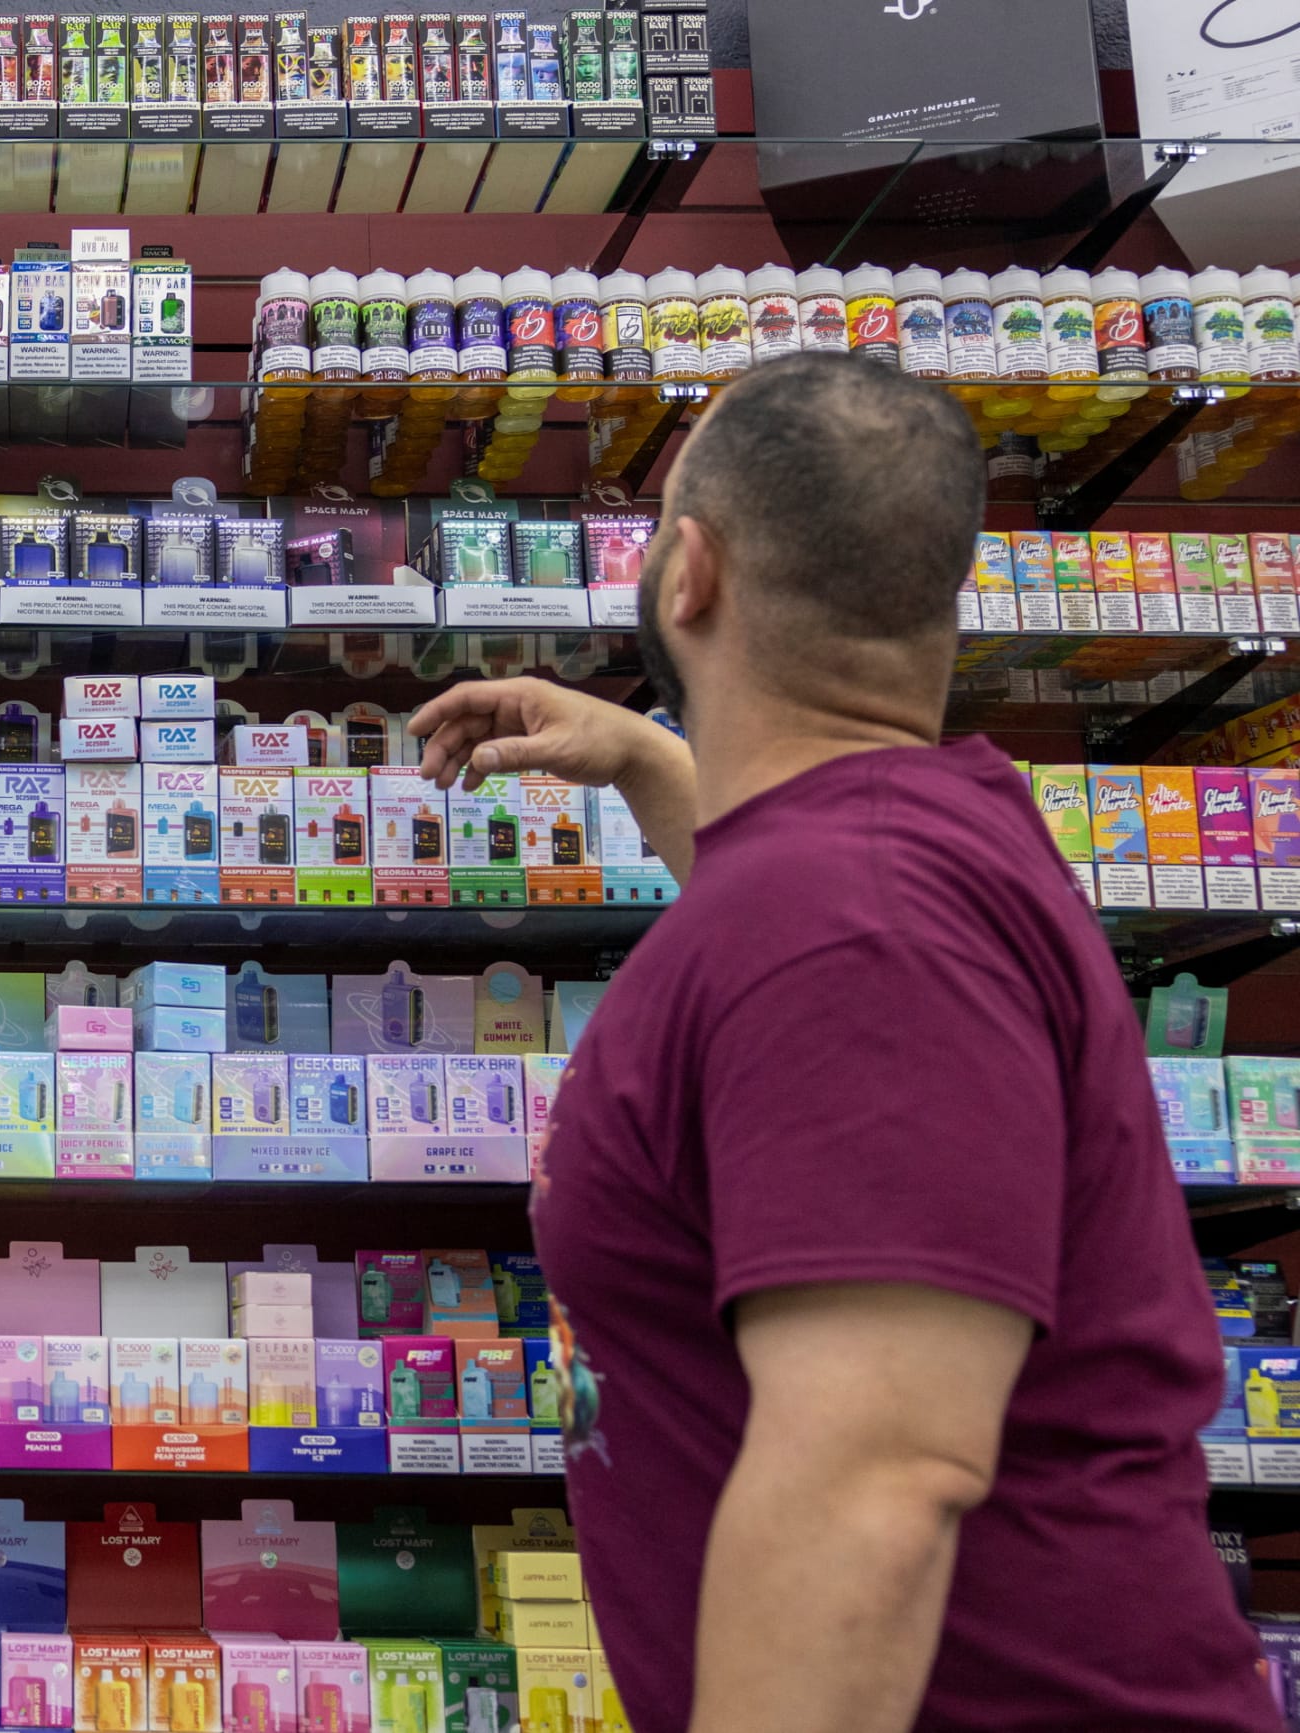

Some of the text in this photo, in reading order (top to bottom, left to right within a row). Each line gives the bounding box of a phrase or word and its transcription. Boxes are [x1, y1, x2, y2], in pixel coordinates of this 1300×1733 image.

[868, 97, 976, 123] GRAVITY INFUSER
[304, 507, 369, 516] SPACE MARY
[442, 510, 507, 519] SPACE MARY
[83, 683, 121, 698] RAZ
[159, 684, 196, 699] RAZ
[78, 724, 116, 739] RAZ
[5, 776, 50, 794] RAZ
[494, 1021, 522, 1030] WHITE
[483, 1033, 534, 1042] GUMMY ICE
[294, 1058, 360, 1071] GEEK BAR
[426, 1147, 474, 1157] GRAPE ICE
[478, 1350, 513, 1360] FIRE
[25, 1444, 62, 1452] PEACH ICE
[292, 1448, 342, 1457] TRIPLE BERRY
[102, 1536, 161, 1545] LOST MARY
[376, 1652, 436, 1661] LOST MARY
